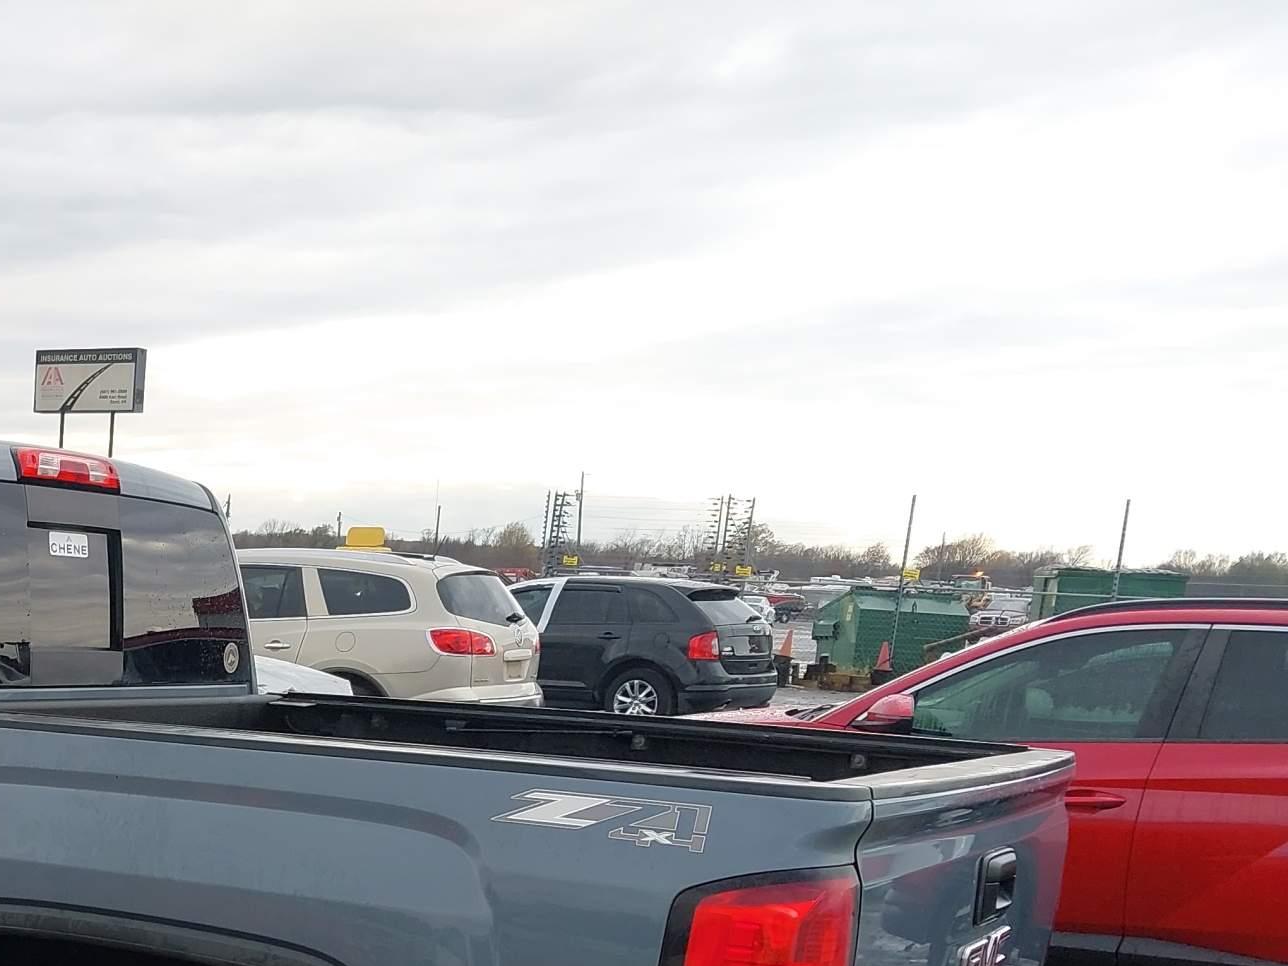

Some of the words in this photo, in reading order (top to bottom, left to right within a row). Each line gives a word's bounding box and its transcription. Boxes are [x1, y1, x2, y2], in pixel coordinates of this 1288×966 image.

[40, 354, 78, 362] INSURANCE
[78, 353, 98, 362] AUTO
[98, 352, 133, 361] AUCTIONS
